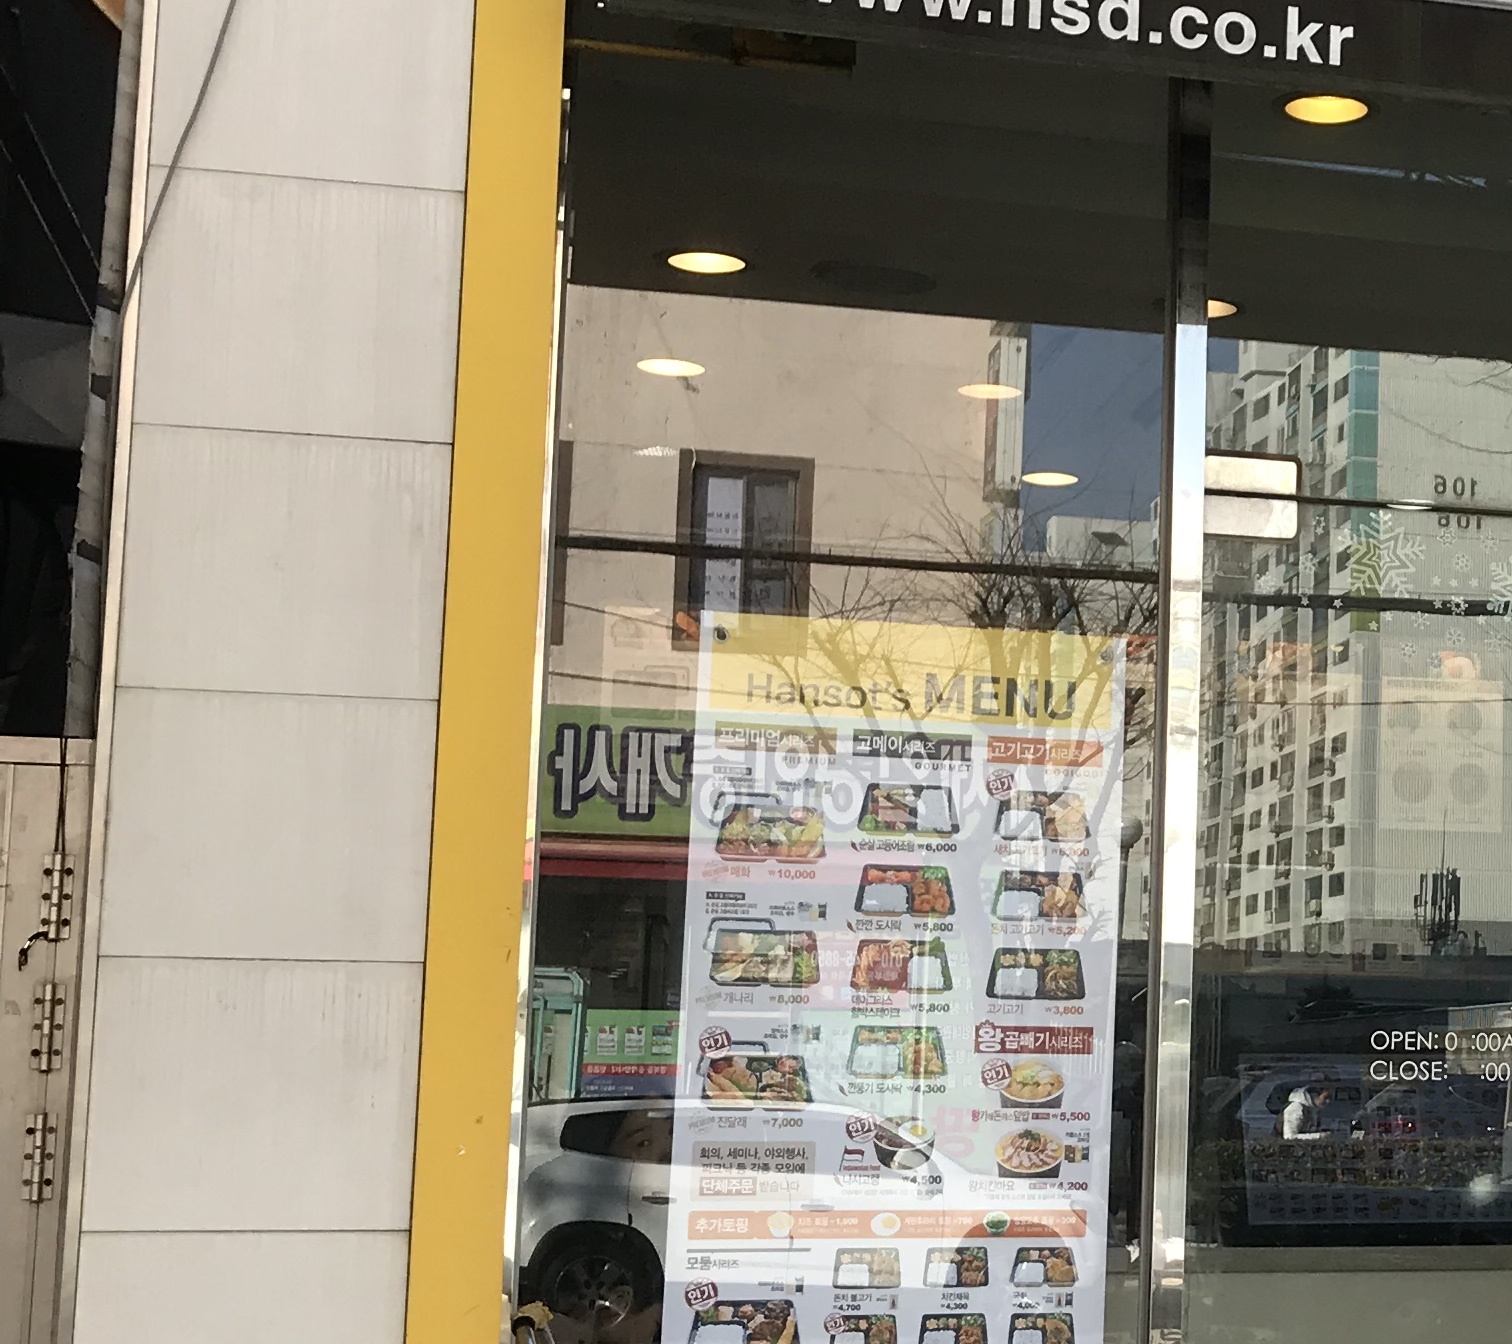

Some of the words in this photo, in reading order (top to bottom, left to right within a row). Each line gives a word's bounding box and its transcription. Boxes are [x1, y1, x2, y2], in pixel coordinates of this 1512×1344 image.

[747, 672, 911, 712] Hansot's
[924, 672, 1076, 720] MENU
[702, 1037, 727, 1052] 인기
[1370, 1031, 1439, 1051] OPEN:
[984, 1068, 1009, 1082] 인기
[1369, 1060, 1448, 1081] CLOSE:
[849, 1121, 875, 1135] 인기
[702, 1179, 754, 1194] 단체주문
[695, 1218, 748, 1232] 추가토핑
[687, 1287, 714, 1303] 인기
